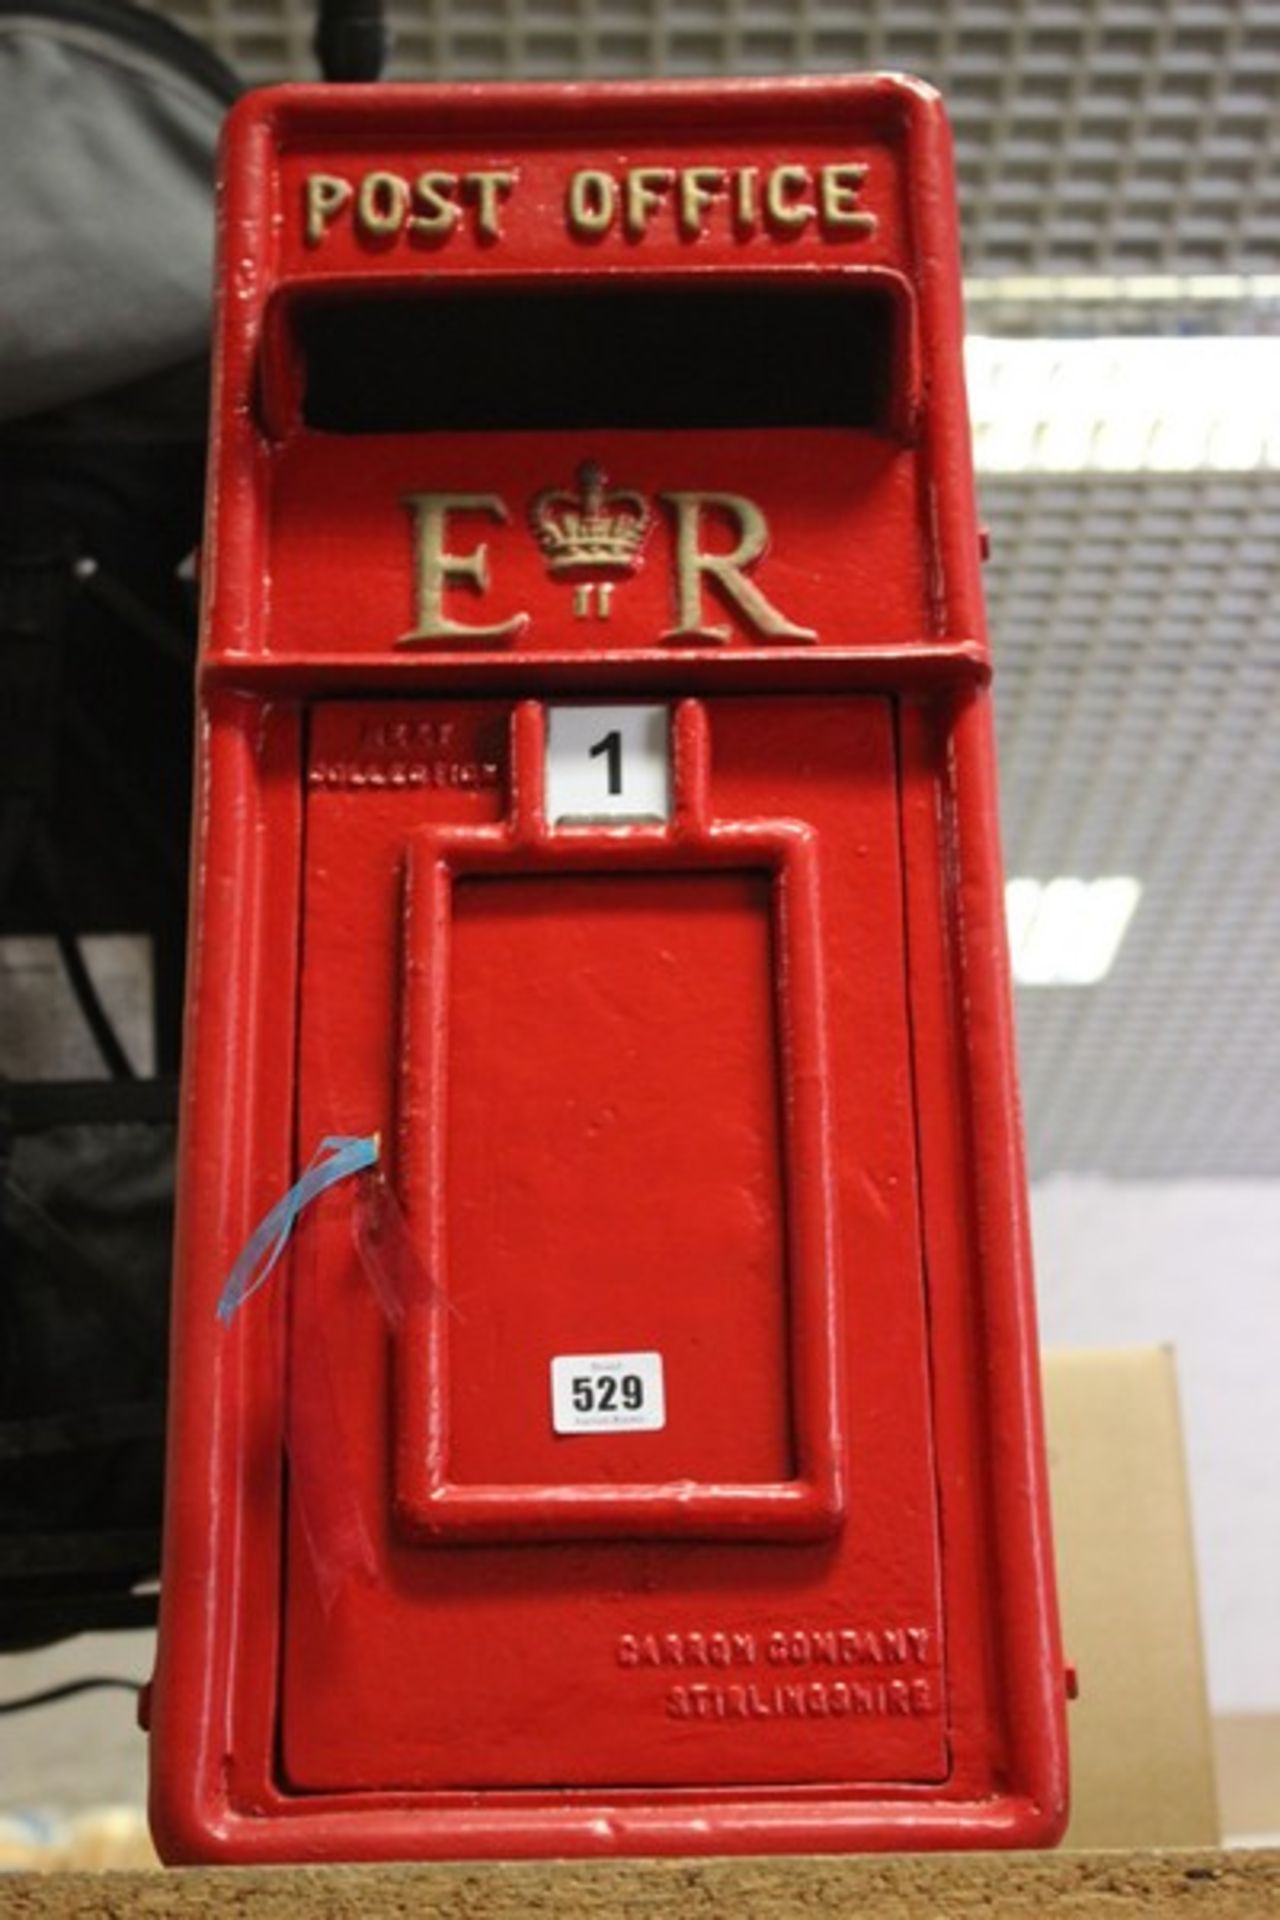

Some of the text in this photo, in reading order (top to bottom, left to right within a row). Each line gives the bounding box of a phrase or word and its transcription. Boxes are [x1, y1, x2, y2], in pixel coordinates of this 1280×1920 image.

[307, 164, 877, 244] POST OFFICE
[395, 491, 818, 645] E R
[588, 729, 622, 795] 1
[572, 1373, 644, 1412] 529
